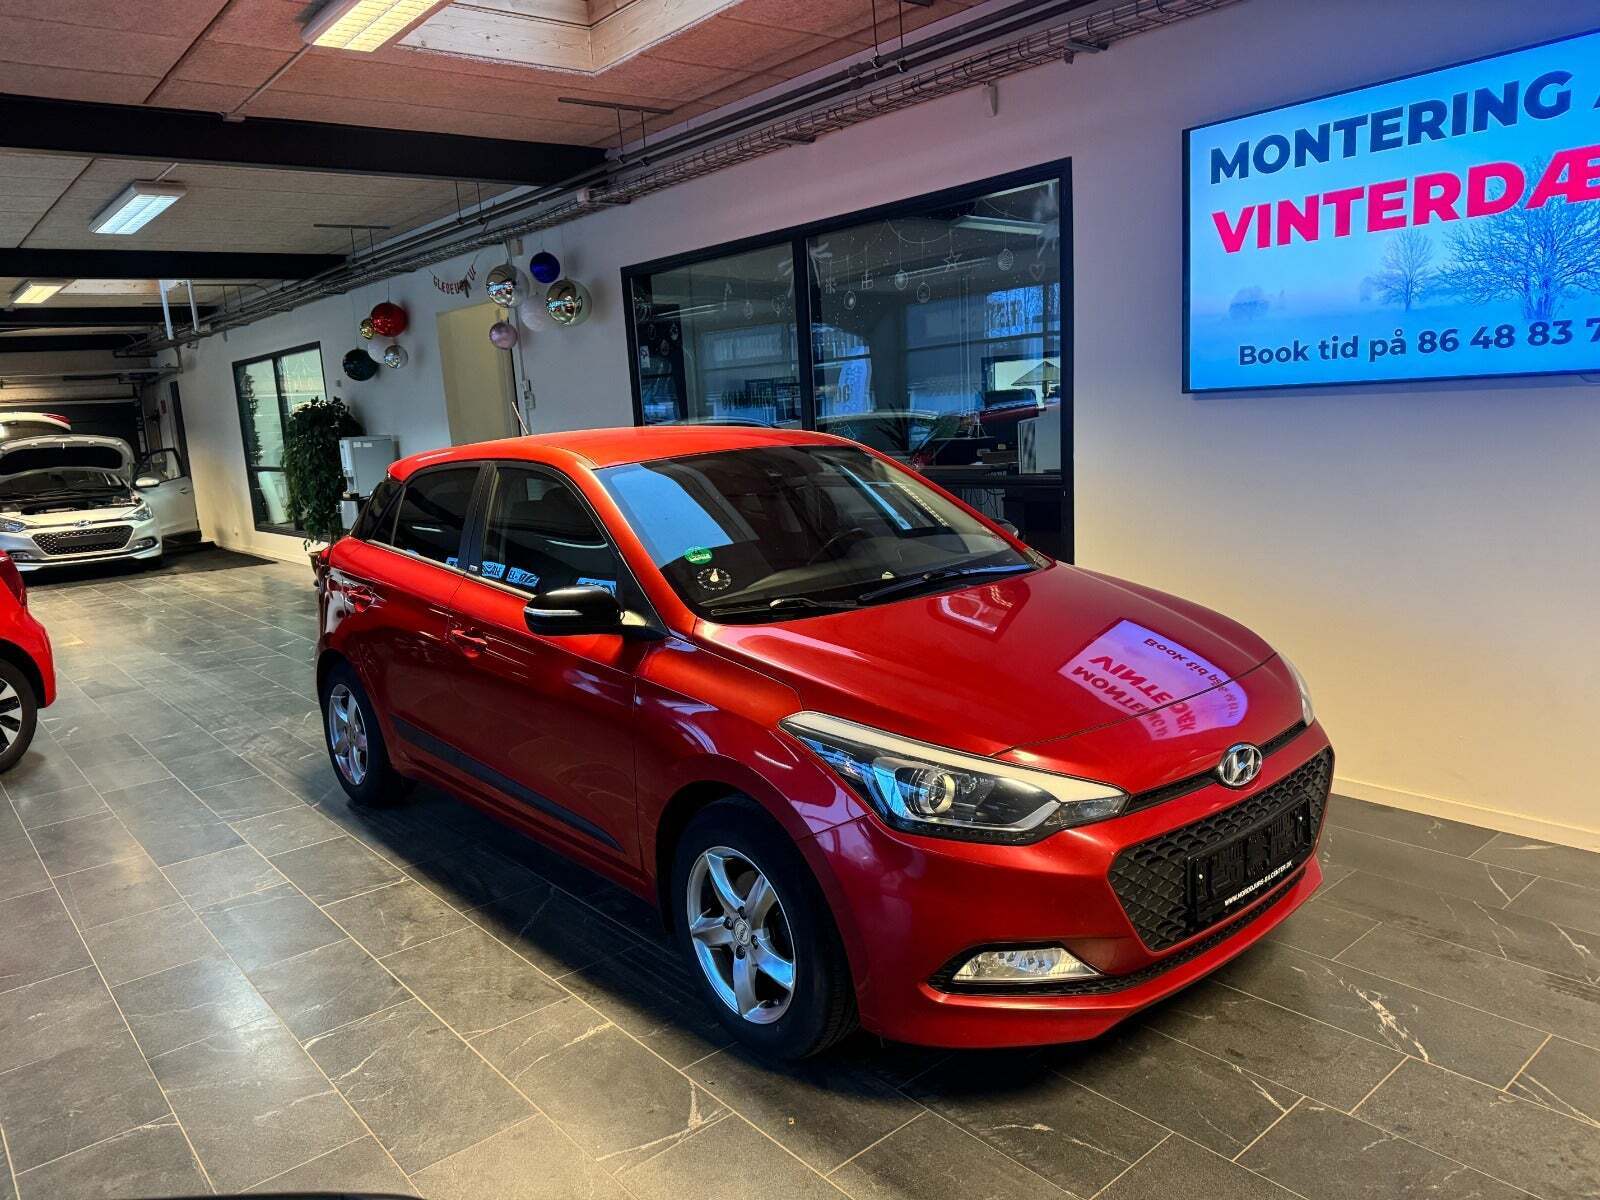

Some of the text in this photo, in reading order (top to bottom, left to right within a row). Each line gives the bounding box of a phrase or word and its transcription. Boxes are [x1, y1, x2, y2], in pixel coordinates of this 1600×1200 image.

[1210, 70, 1573, 185] MONTERING
[1239, 339, 1309, 366] Book
[1318, 335, 1359, 361] tid
[1368, 328, 1408, 363] på
[1417, 328, 1460, 354] 86
[1470, 323, 1516, 350] 48
[1527, 319, 1573, 347] 83
